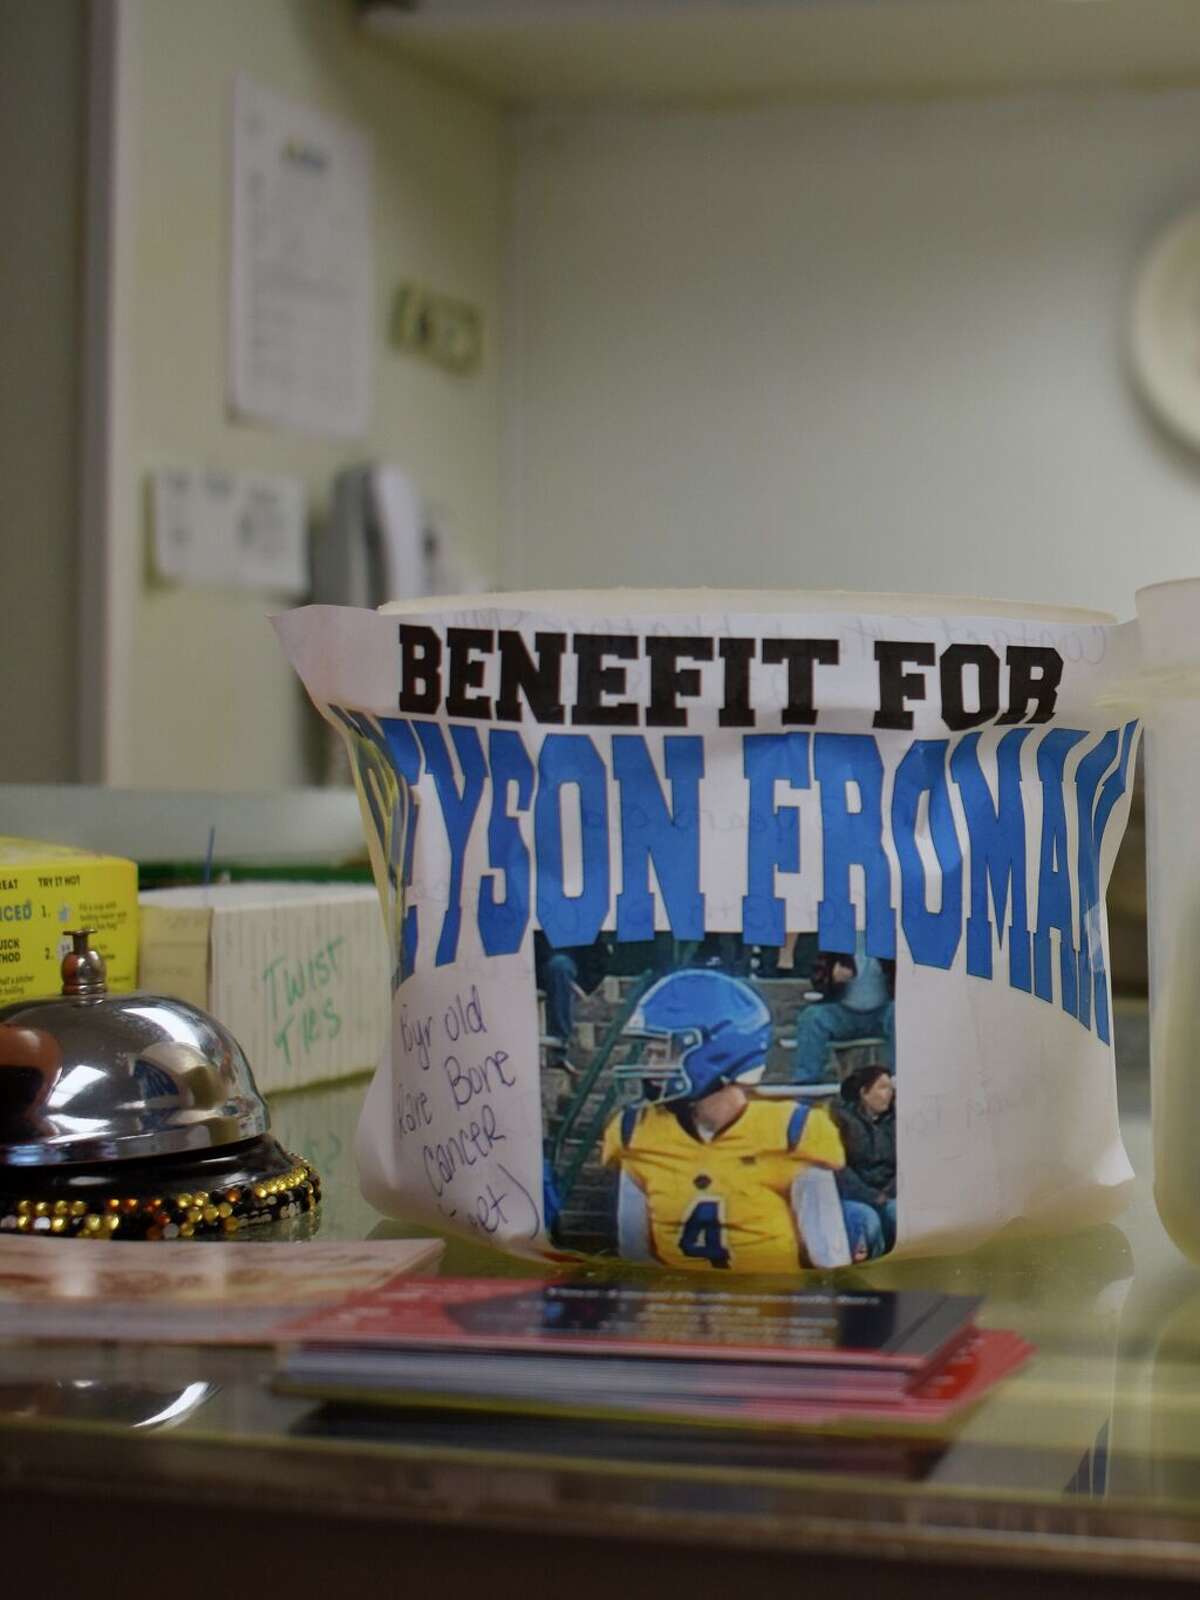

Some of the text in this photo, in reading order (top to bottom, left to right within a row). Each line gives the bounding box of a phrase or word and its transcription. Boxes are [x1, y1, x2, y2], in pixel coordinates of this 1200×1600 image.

[399, 623, 1064, 732] BENEFIT FOR
[38, 877, 54, 888] TRY
[350, 708, 706, 990] YSON
[262, 936, 345, 1020] TWIST
[445, 985, 487, 1041] old
[444, 1050, 516, 1109] Bone
[678, 1200, 733, 1270] 4
